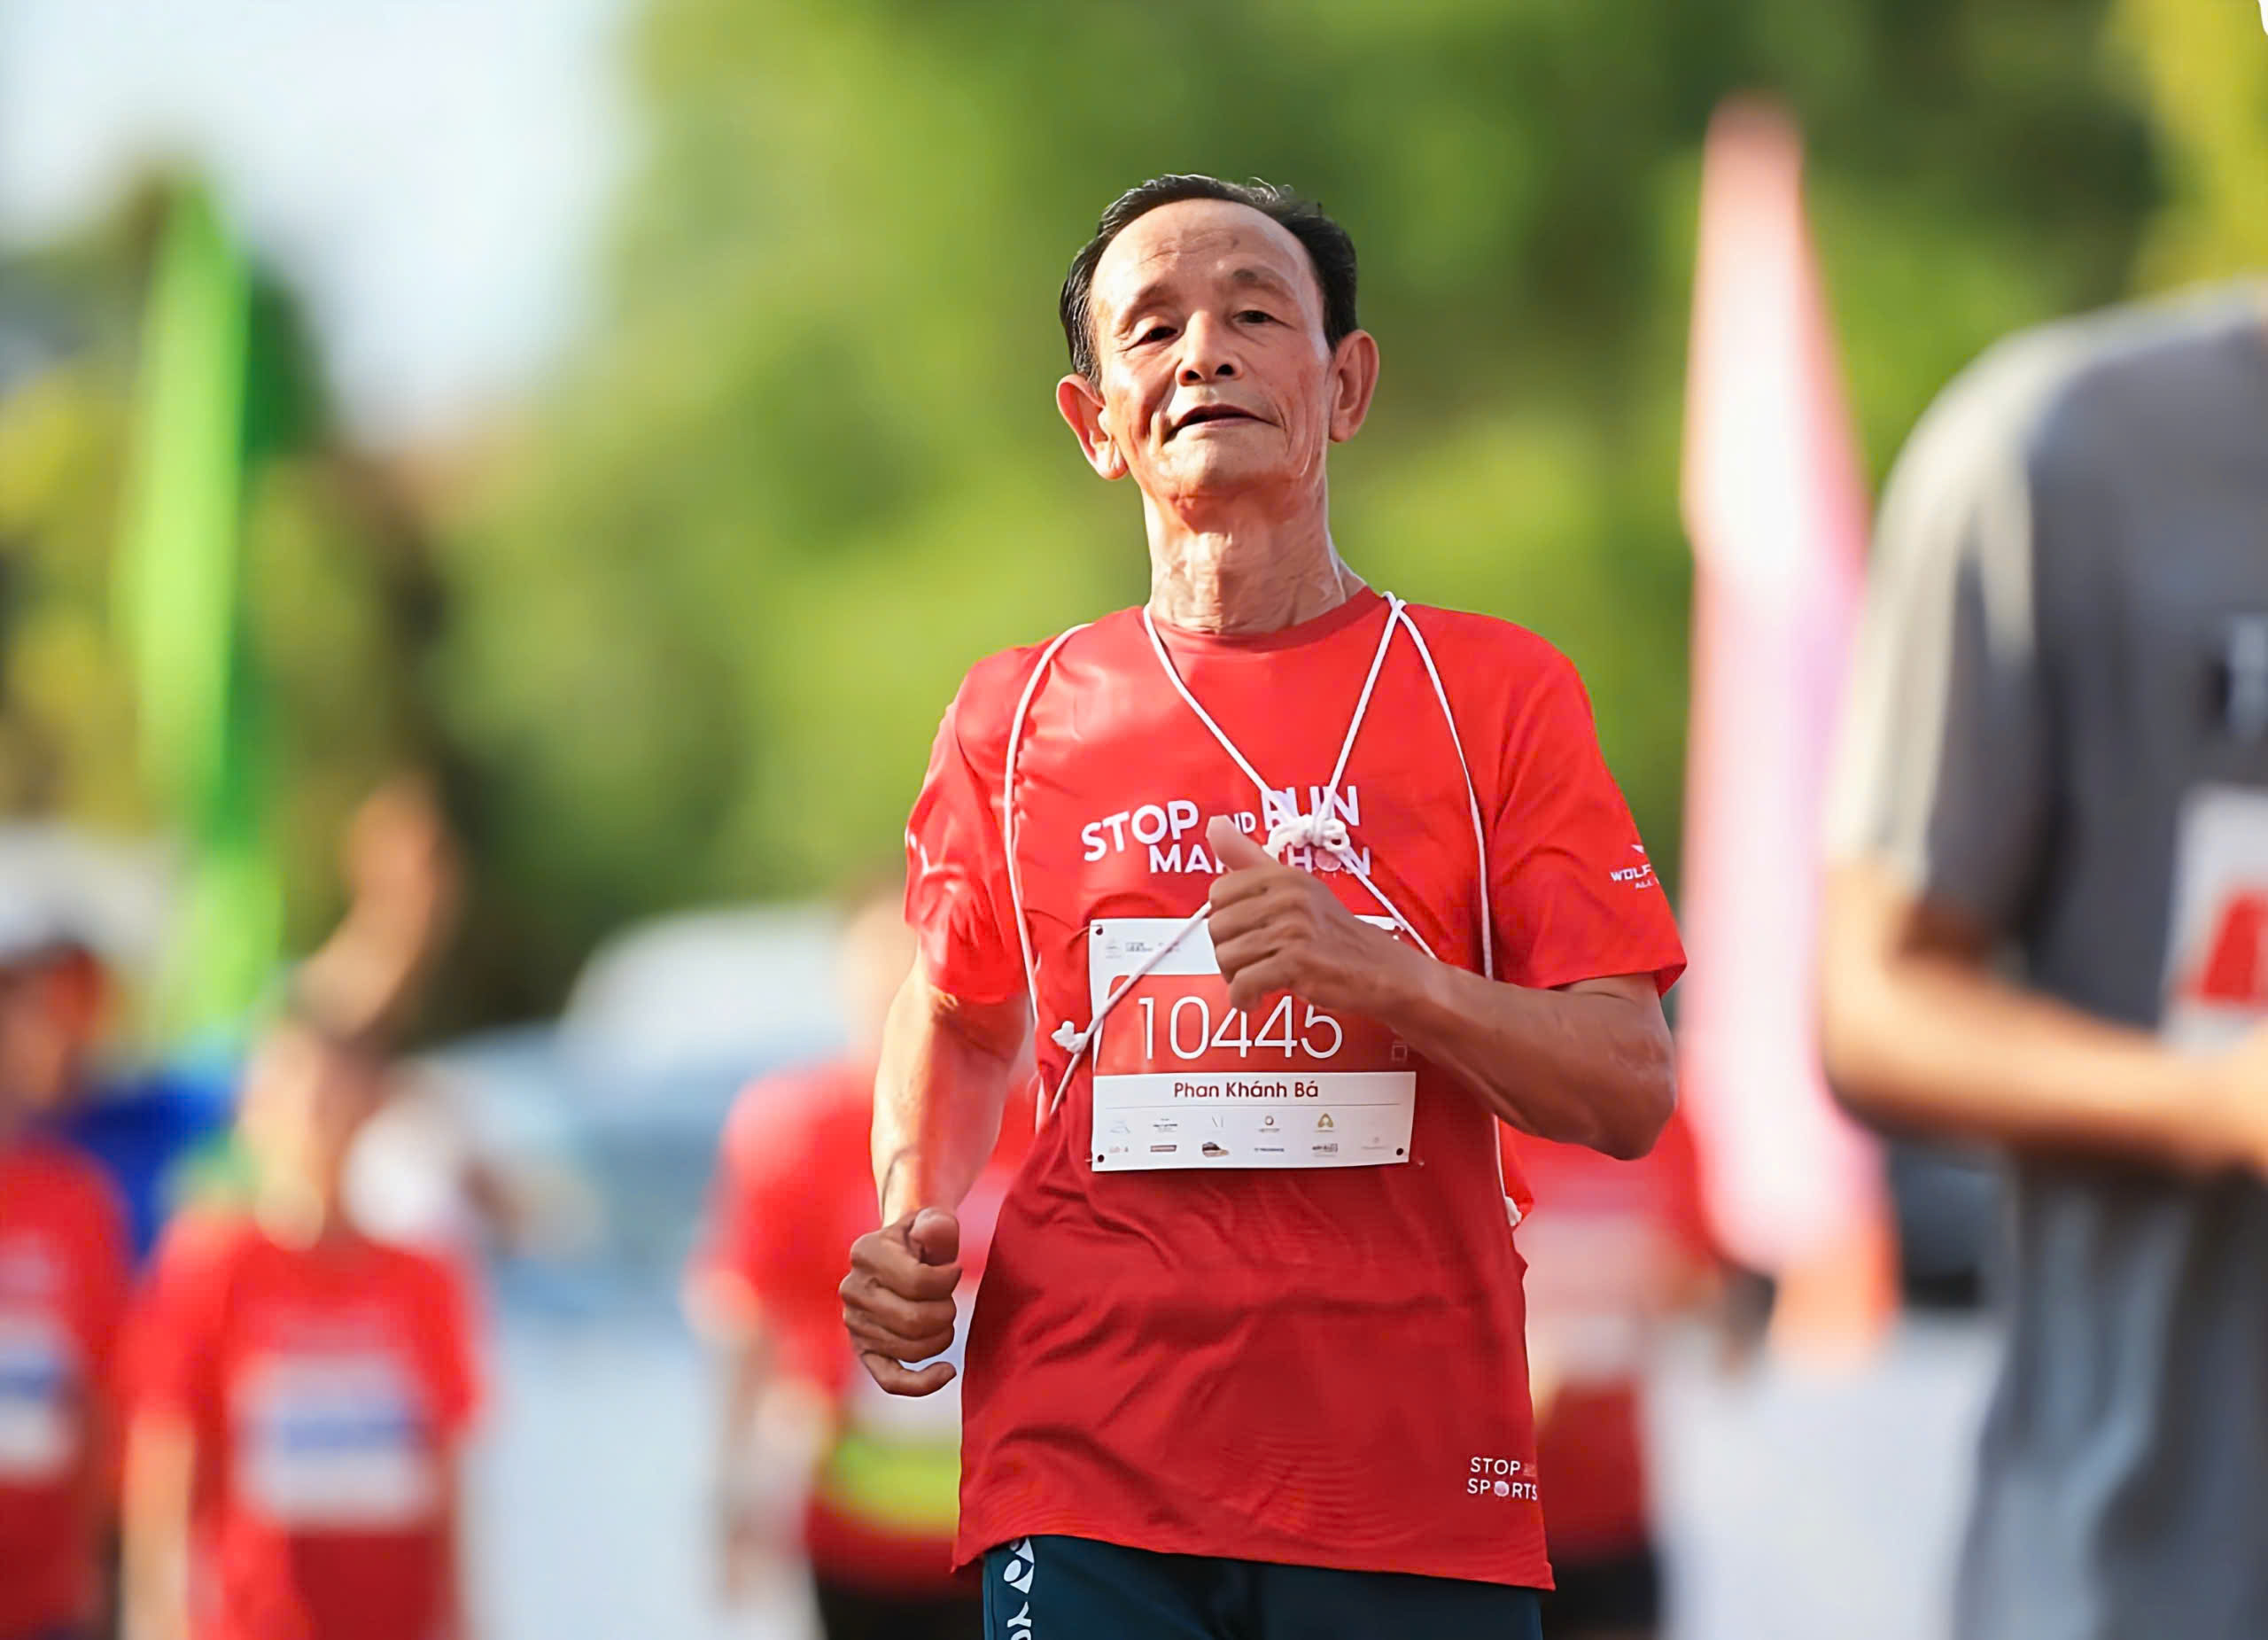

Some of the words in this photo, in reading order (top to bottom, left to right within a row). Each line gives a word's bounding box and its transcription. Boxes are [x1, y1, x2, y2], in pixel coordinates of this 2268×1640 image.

[1081, 800, 1199, 862] STOP
[1138, 995, 1343, 1060] 10445
[1174, 1082, 1220, 1098] Phan
[1226, 1080, 1287, 1098] Khánh
[1294, 1080, 1319, 1098] Bá
[1470, 1457, 1521, 1476] STOP
